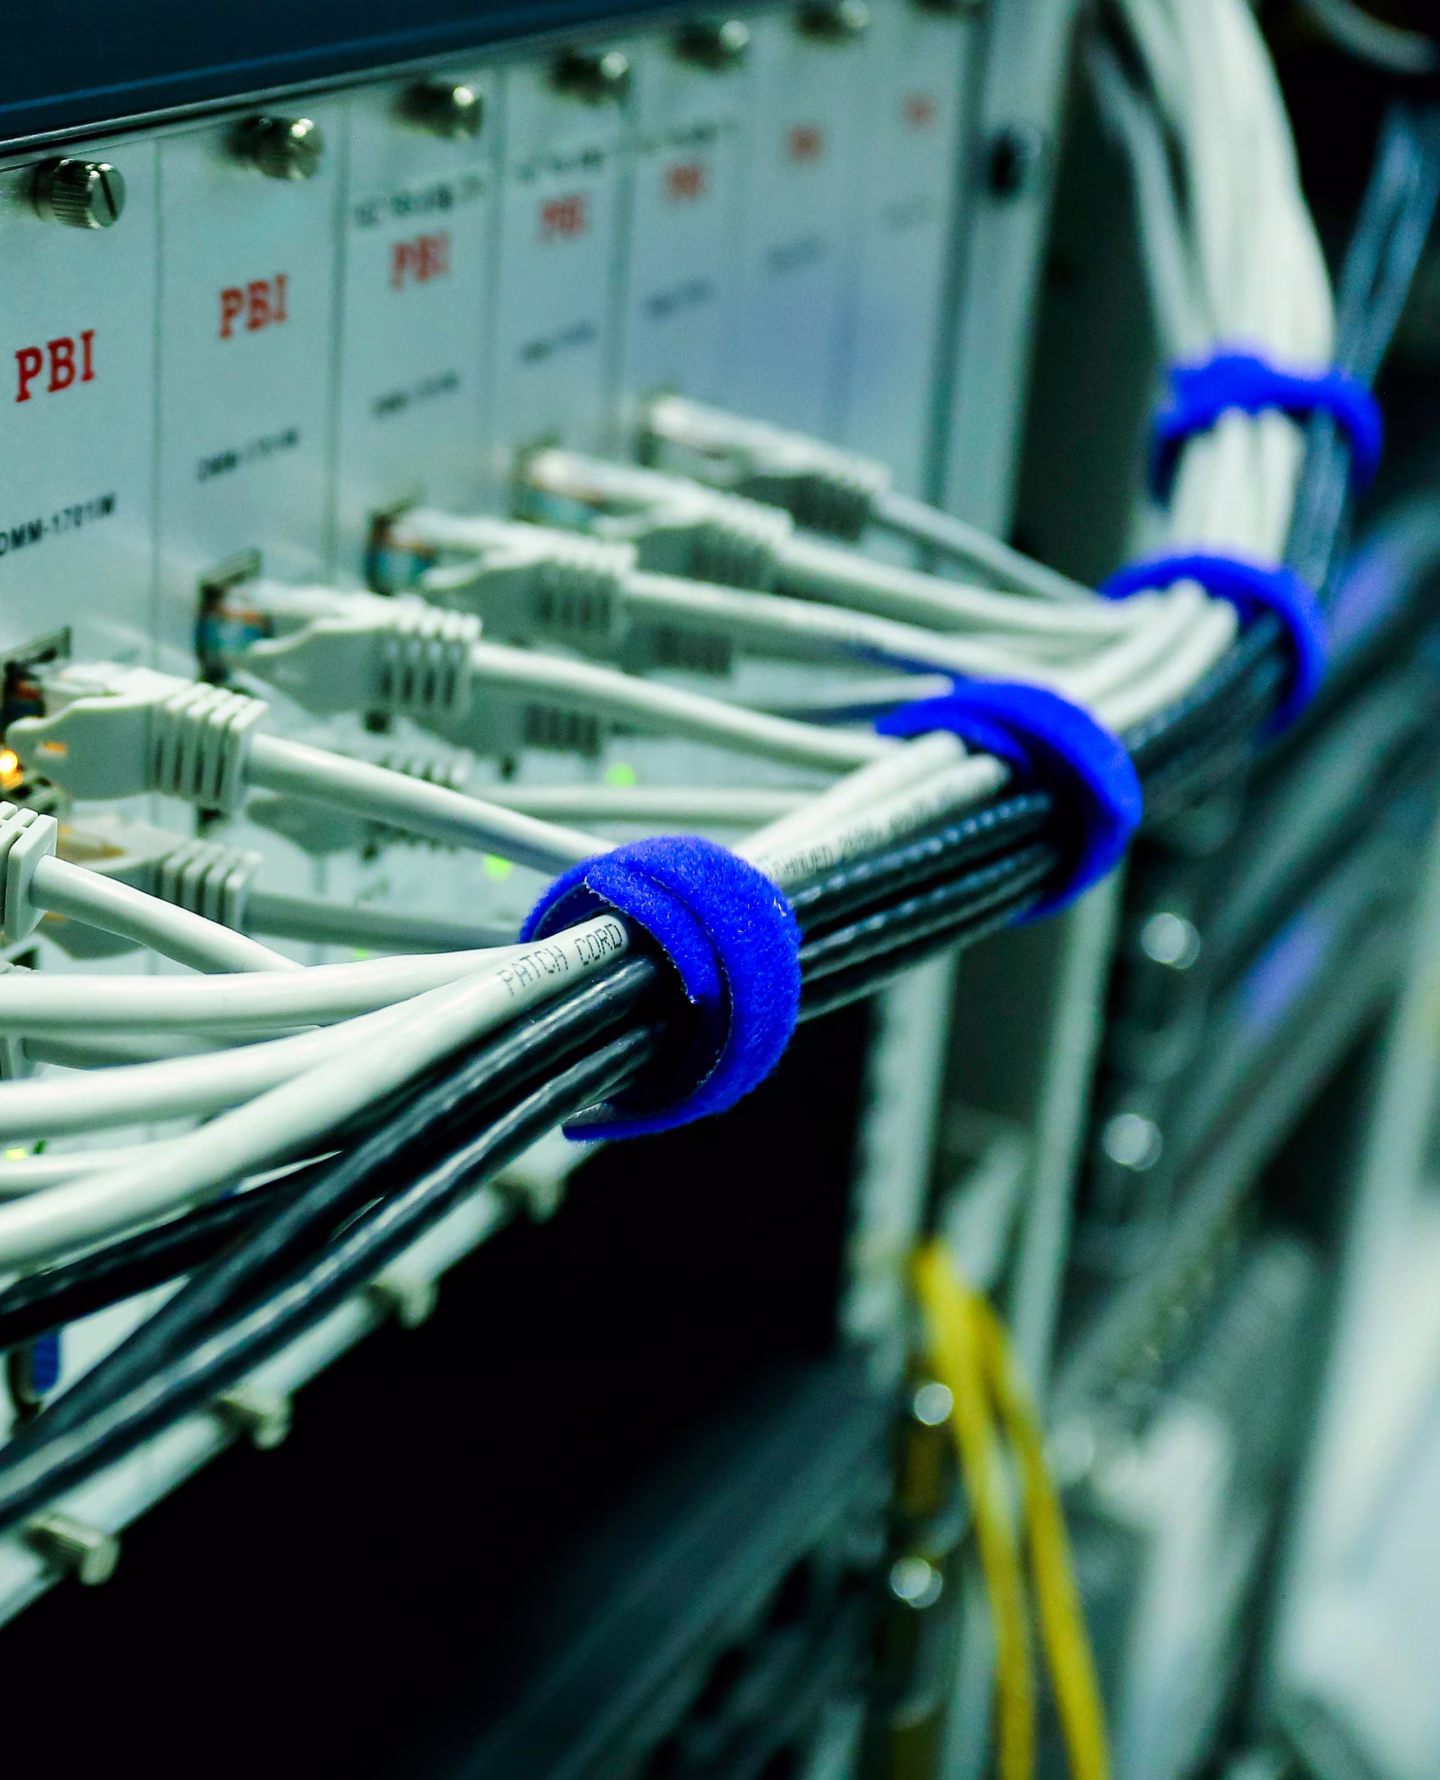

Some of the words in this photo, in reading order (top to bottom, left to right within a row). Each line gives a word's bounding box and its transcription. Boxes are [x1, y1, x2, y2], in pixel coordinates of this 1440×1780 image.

[15, 331, 95, 402] PBI
[496, 944, 570, 995] PATCH
[573, 922, 623, 966] CORD
